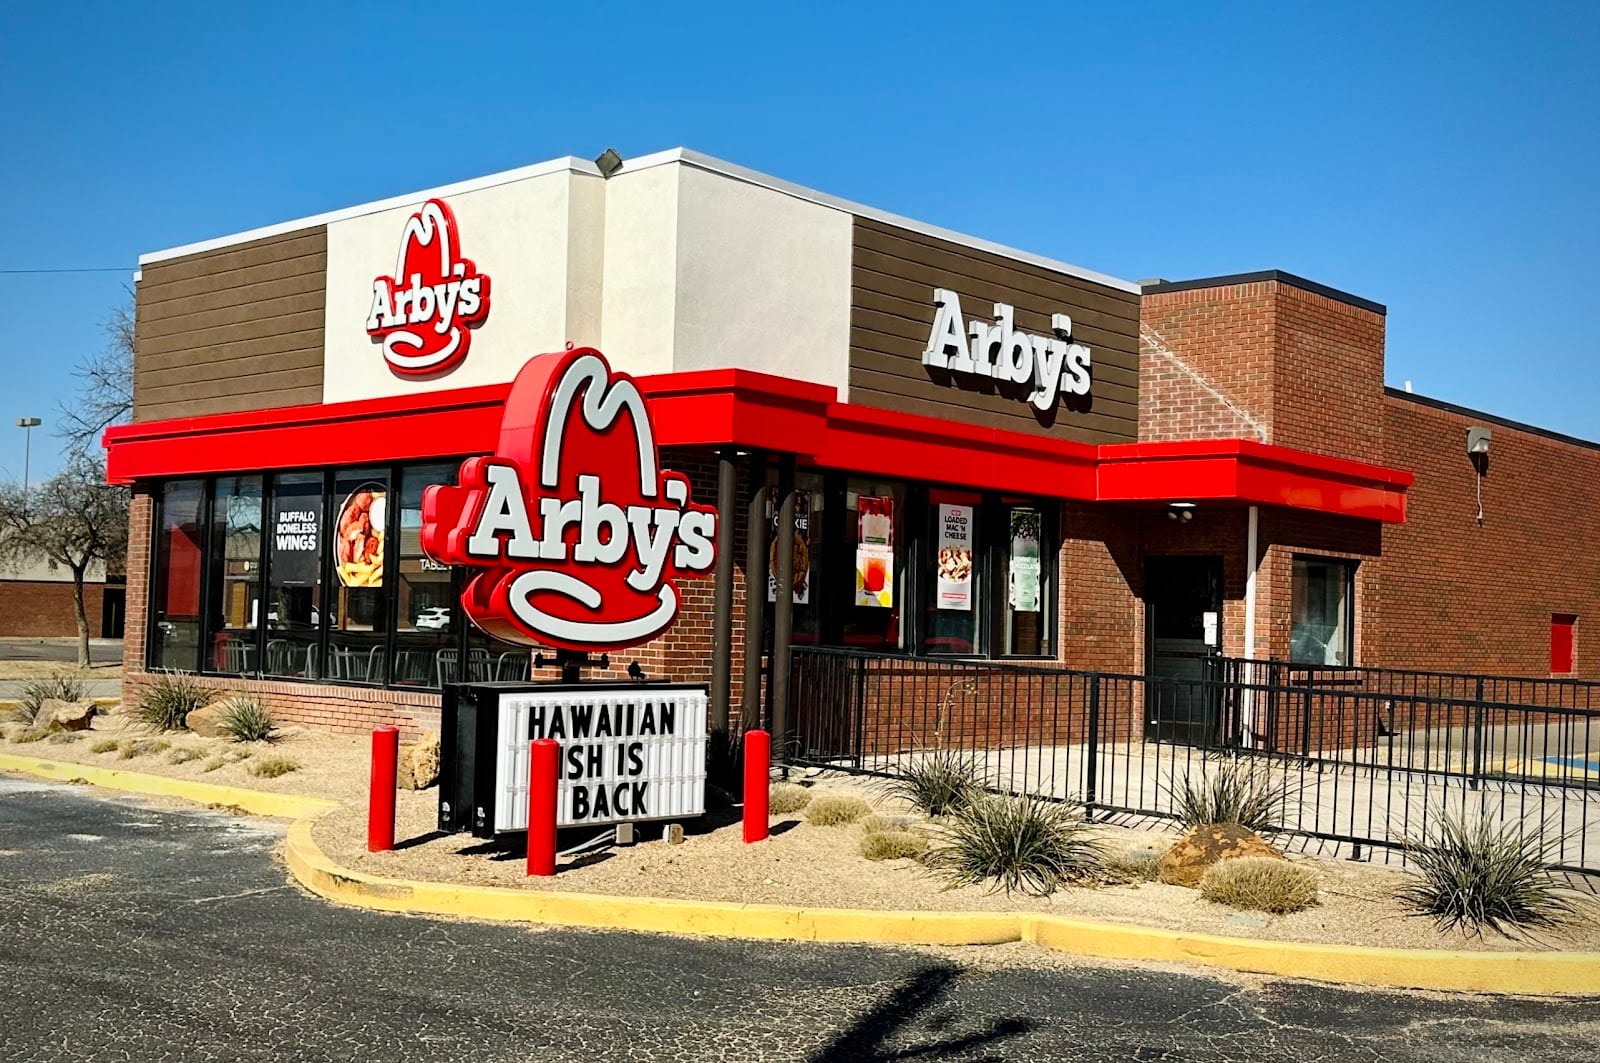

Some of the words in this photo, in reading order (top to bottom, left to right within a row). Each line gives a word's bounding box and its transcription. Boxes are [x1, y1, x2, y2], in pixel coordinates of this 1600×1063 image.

[367, 262, 481, 334] Arby's
[921, 288, 1091, 410] Arby's
[277, 523, 318, 534] BONELESS
[280, 511, 315, 522] BUFFALO
[468, 464, 715, 591] Arby's
[774, 516, 808, 529] CKIE
[945, 516, 967, 524] LOADED
[276, 535, 317, 550] WINGS
[945, 532, 967, 540] CHEESE
[528, 702, 675, 740] HAWAIIAN
[559, 744, 602, 779] ISH
[617, 742, 643, 776] IS
[572, 781, 648, 820] BACK
